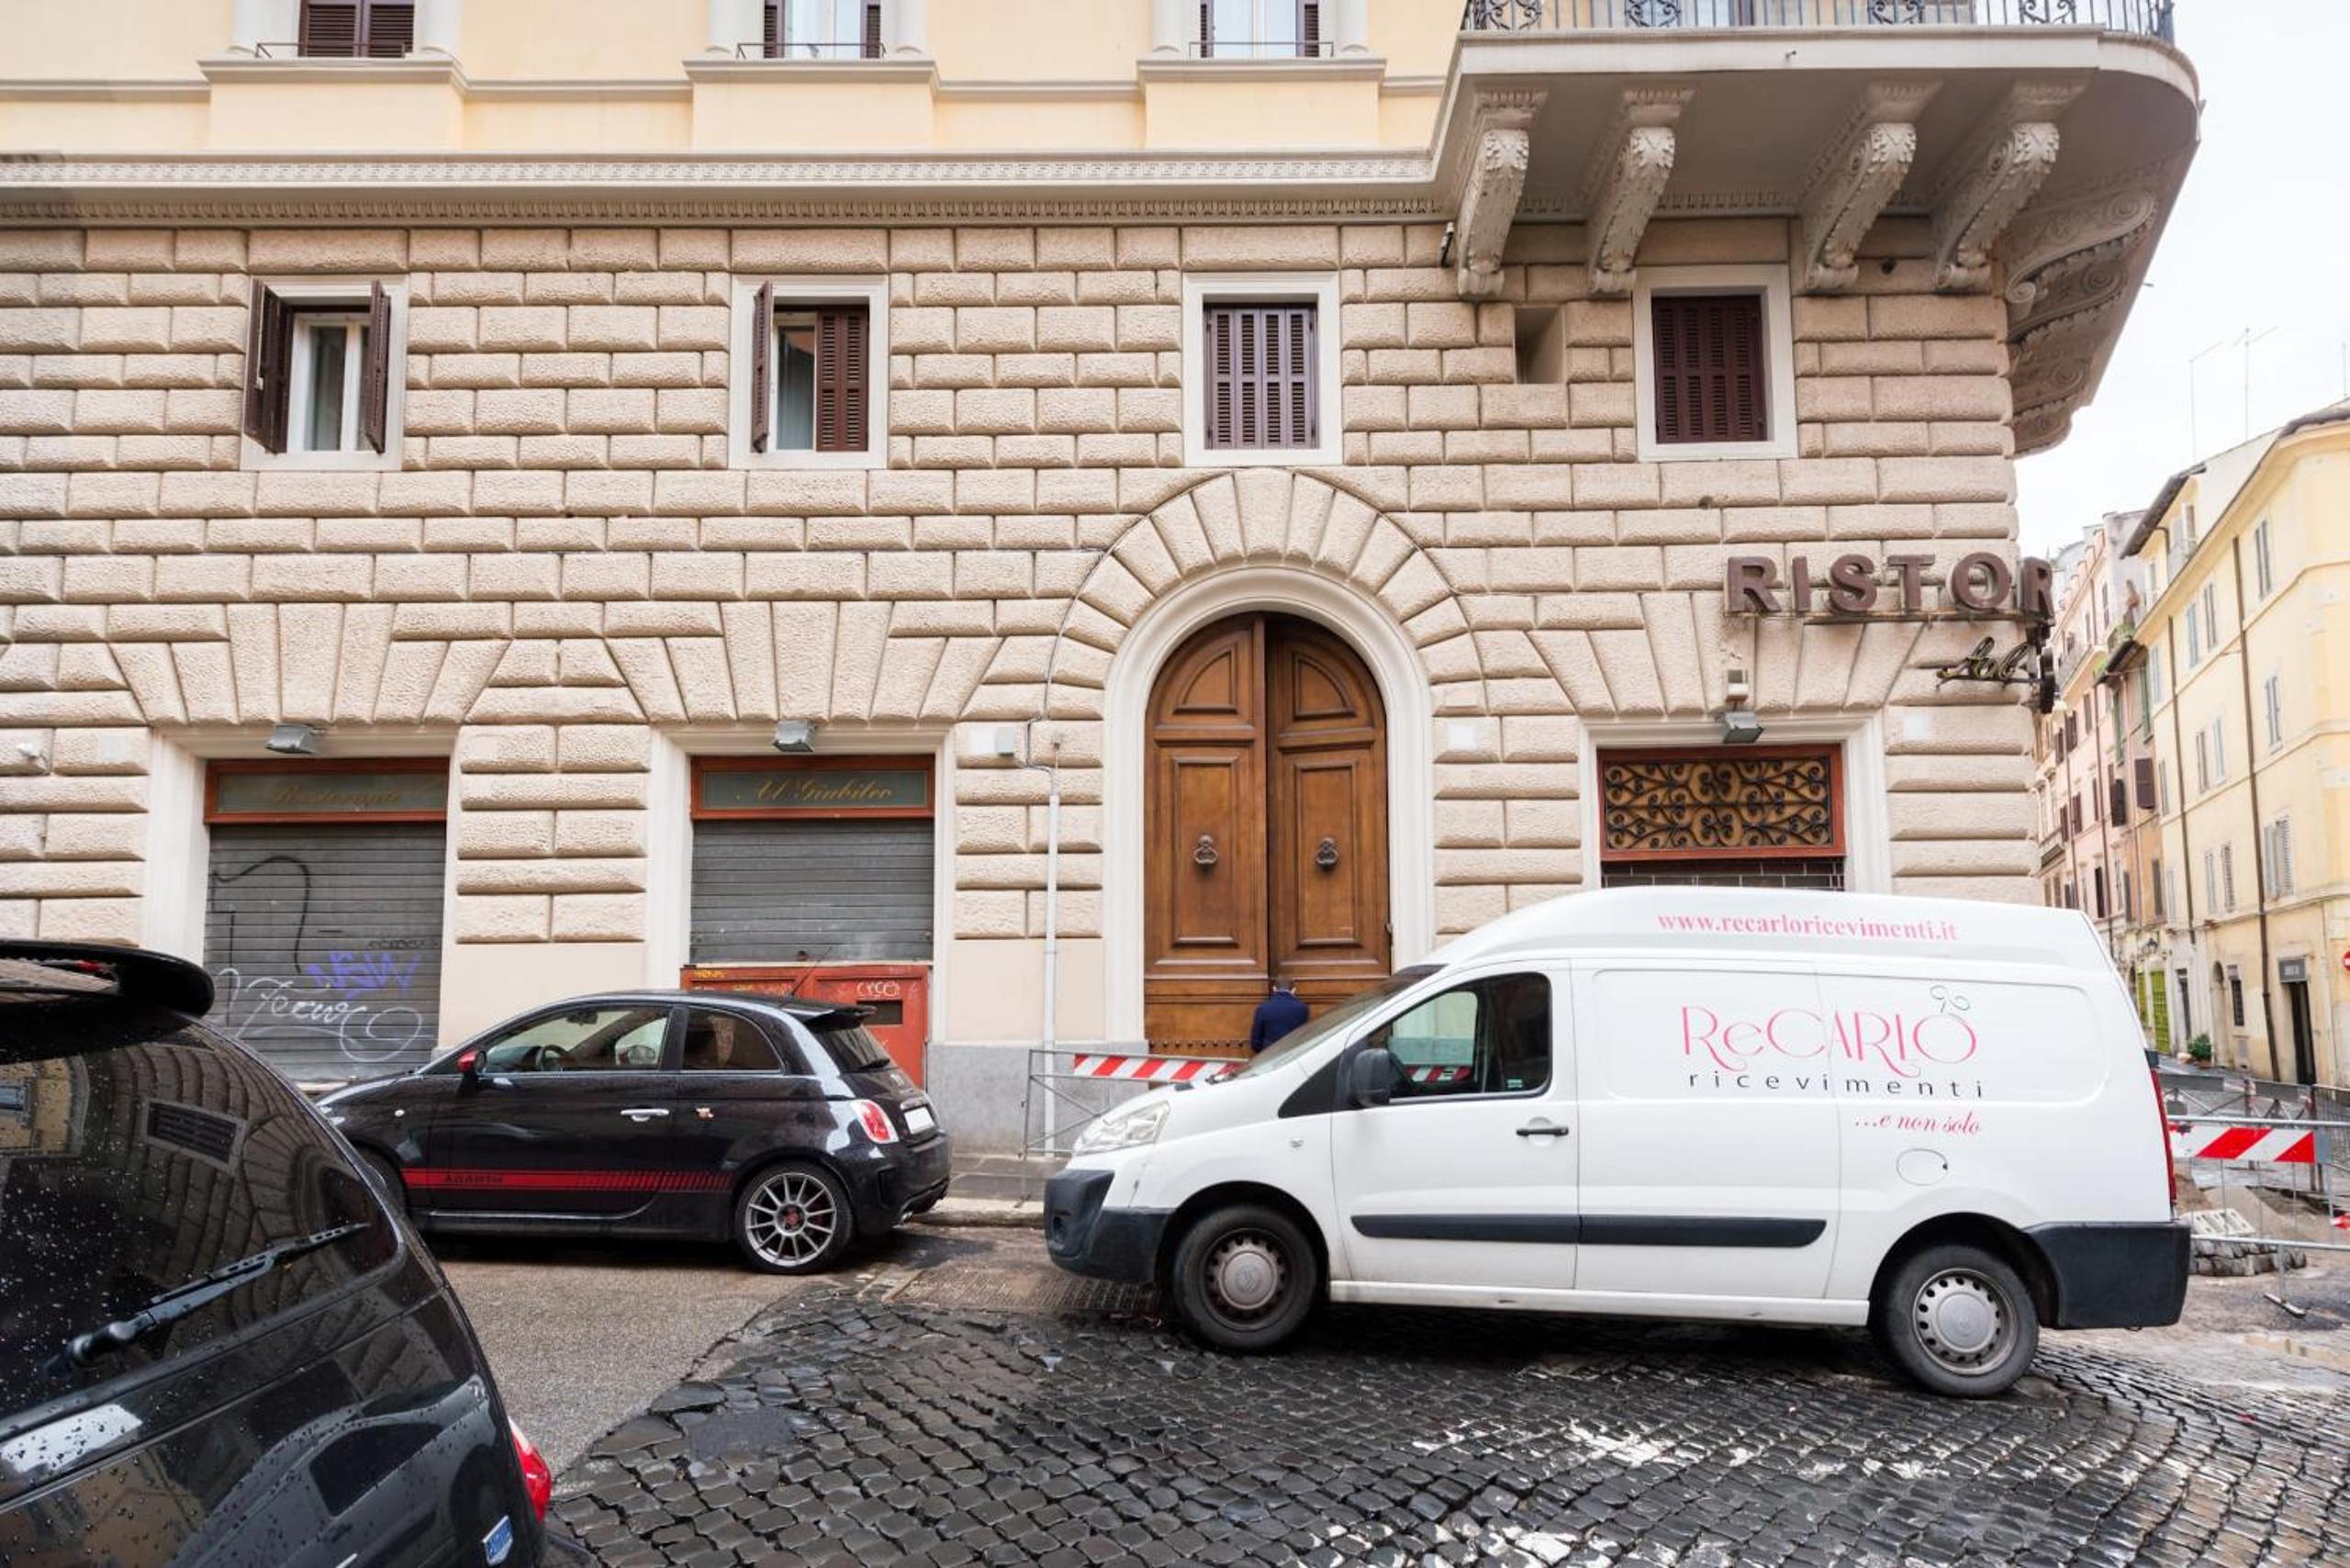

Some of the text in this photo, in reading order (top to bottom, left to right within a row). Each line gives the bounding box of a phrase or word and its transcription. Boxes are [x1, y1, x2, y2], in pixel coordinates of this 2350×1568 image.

[1726, 552, 2054, 618] RISTOR
[1657, 913, 1958, 941] www.recarloricevimenti.it
[1689, 1070, 1984, 1098] ricevimenti
[1897, 1115, 1938, 1131] non
[1942, 1109, 1981, 1135] solo
